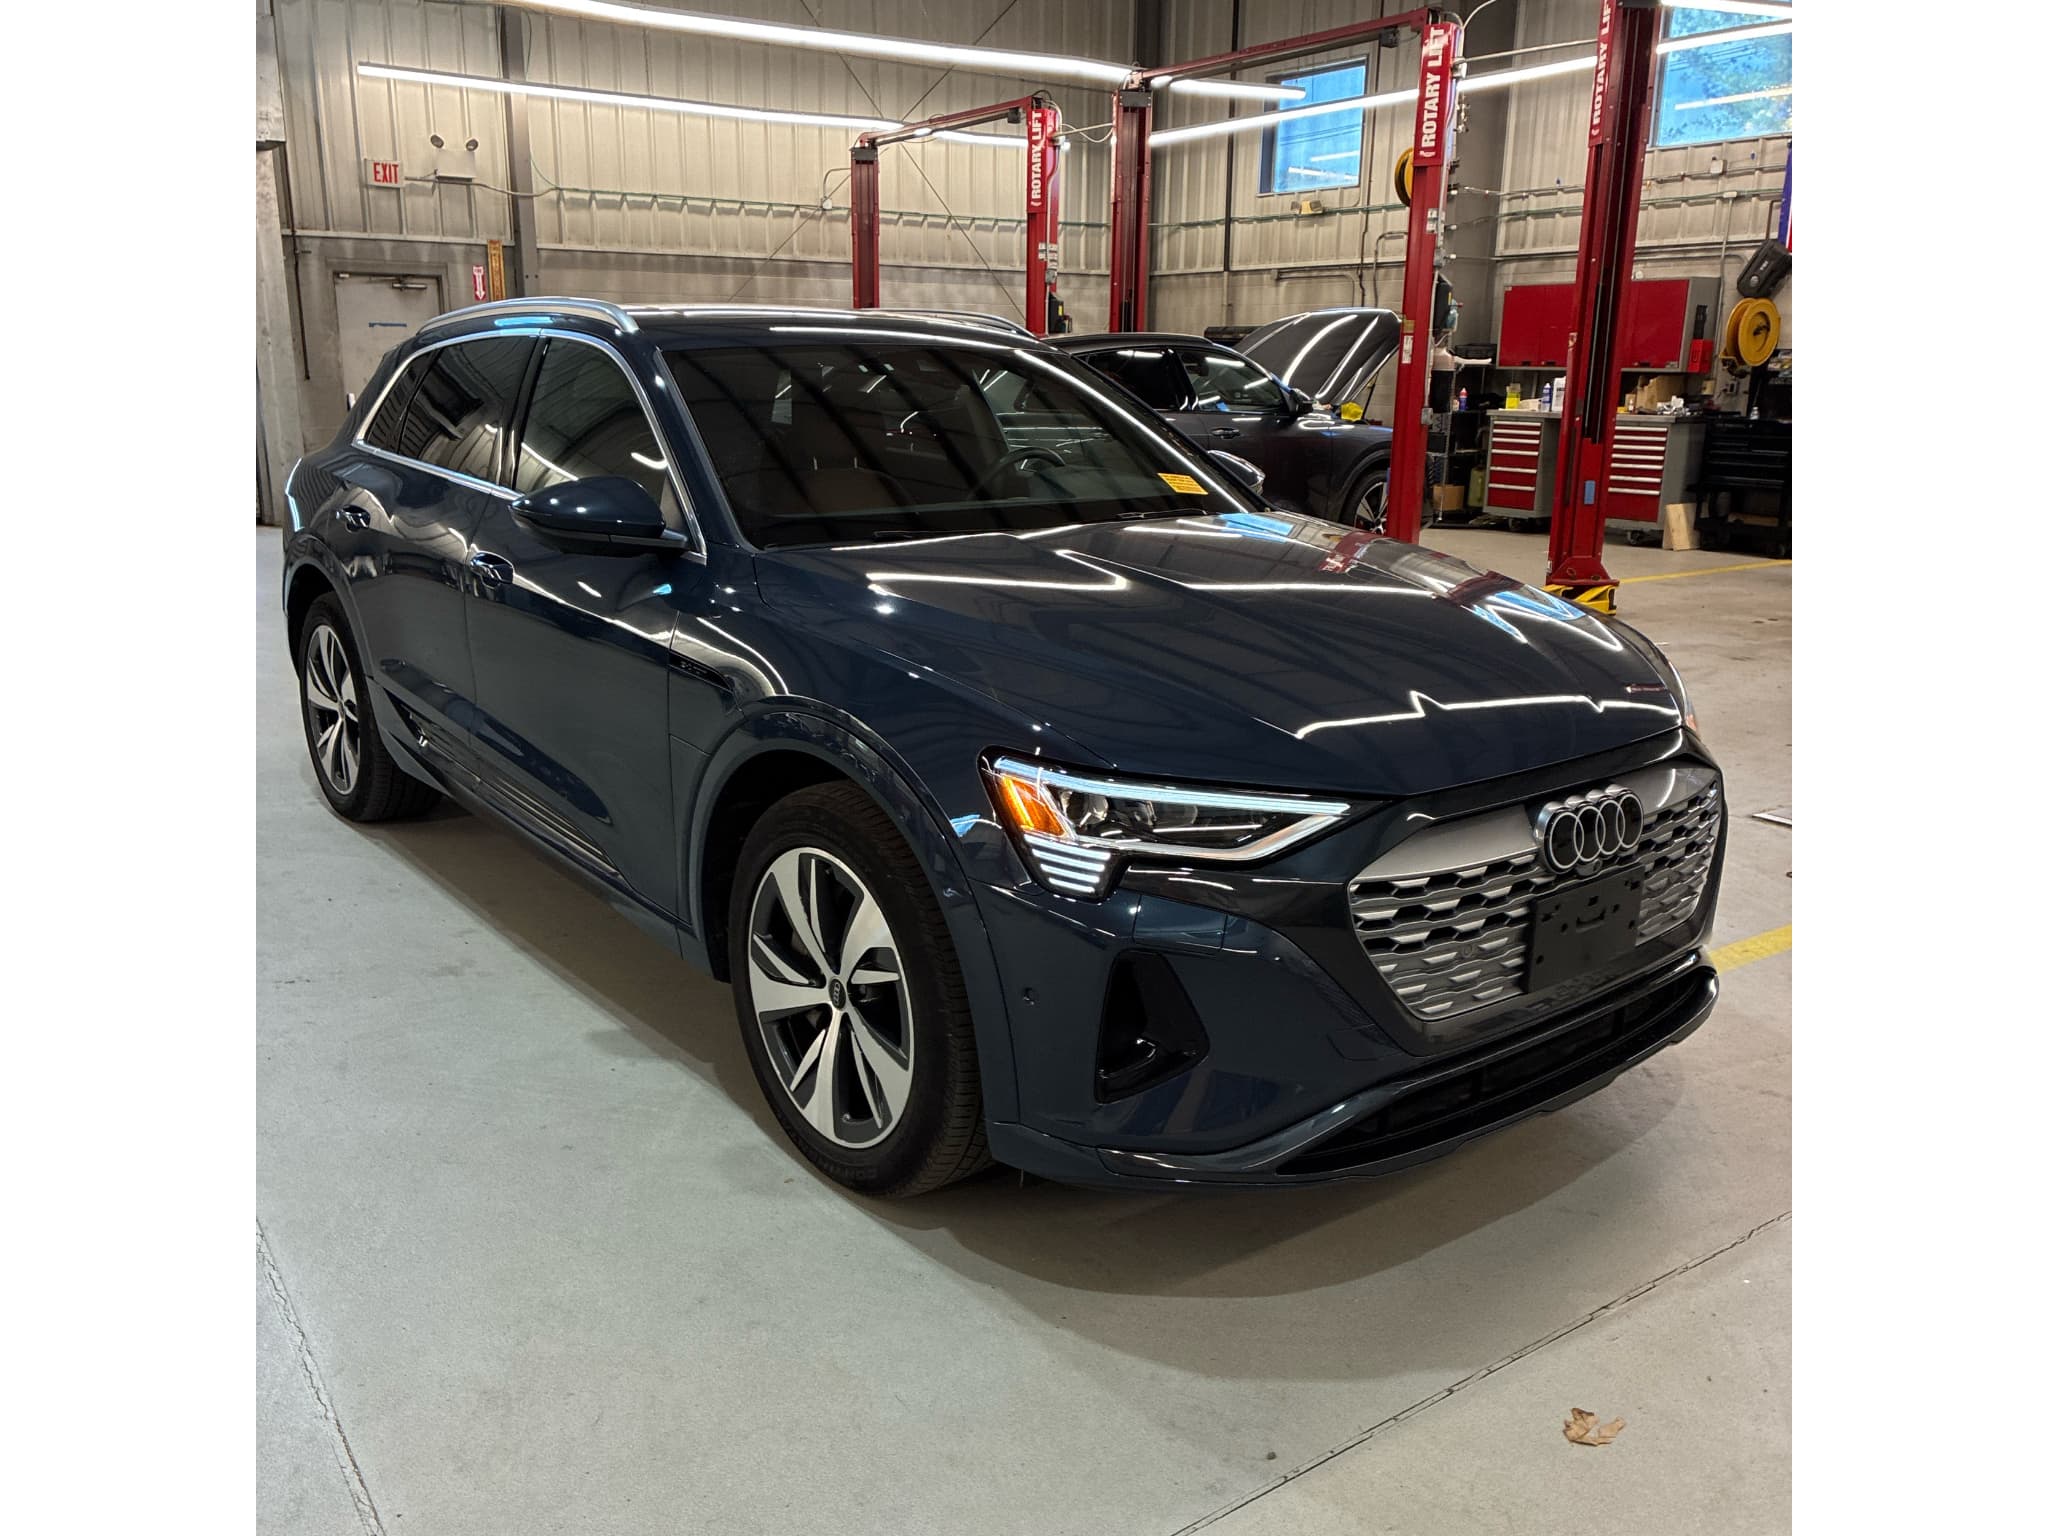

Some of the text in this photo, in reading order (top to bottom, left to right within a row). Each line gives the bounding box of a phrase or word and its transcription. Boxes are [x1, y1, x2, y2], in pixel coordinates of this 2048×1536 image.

[1421, 27, 1445, 147] ROTARY LIFT
[1592, 0, 1612, 125] ROTARY LIF
[373, 161, 399, 184] EXIT
[1031, 111, 1042, 199] ROTARY LIFT
